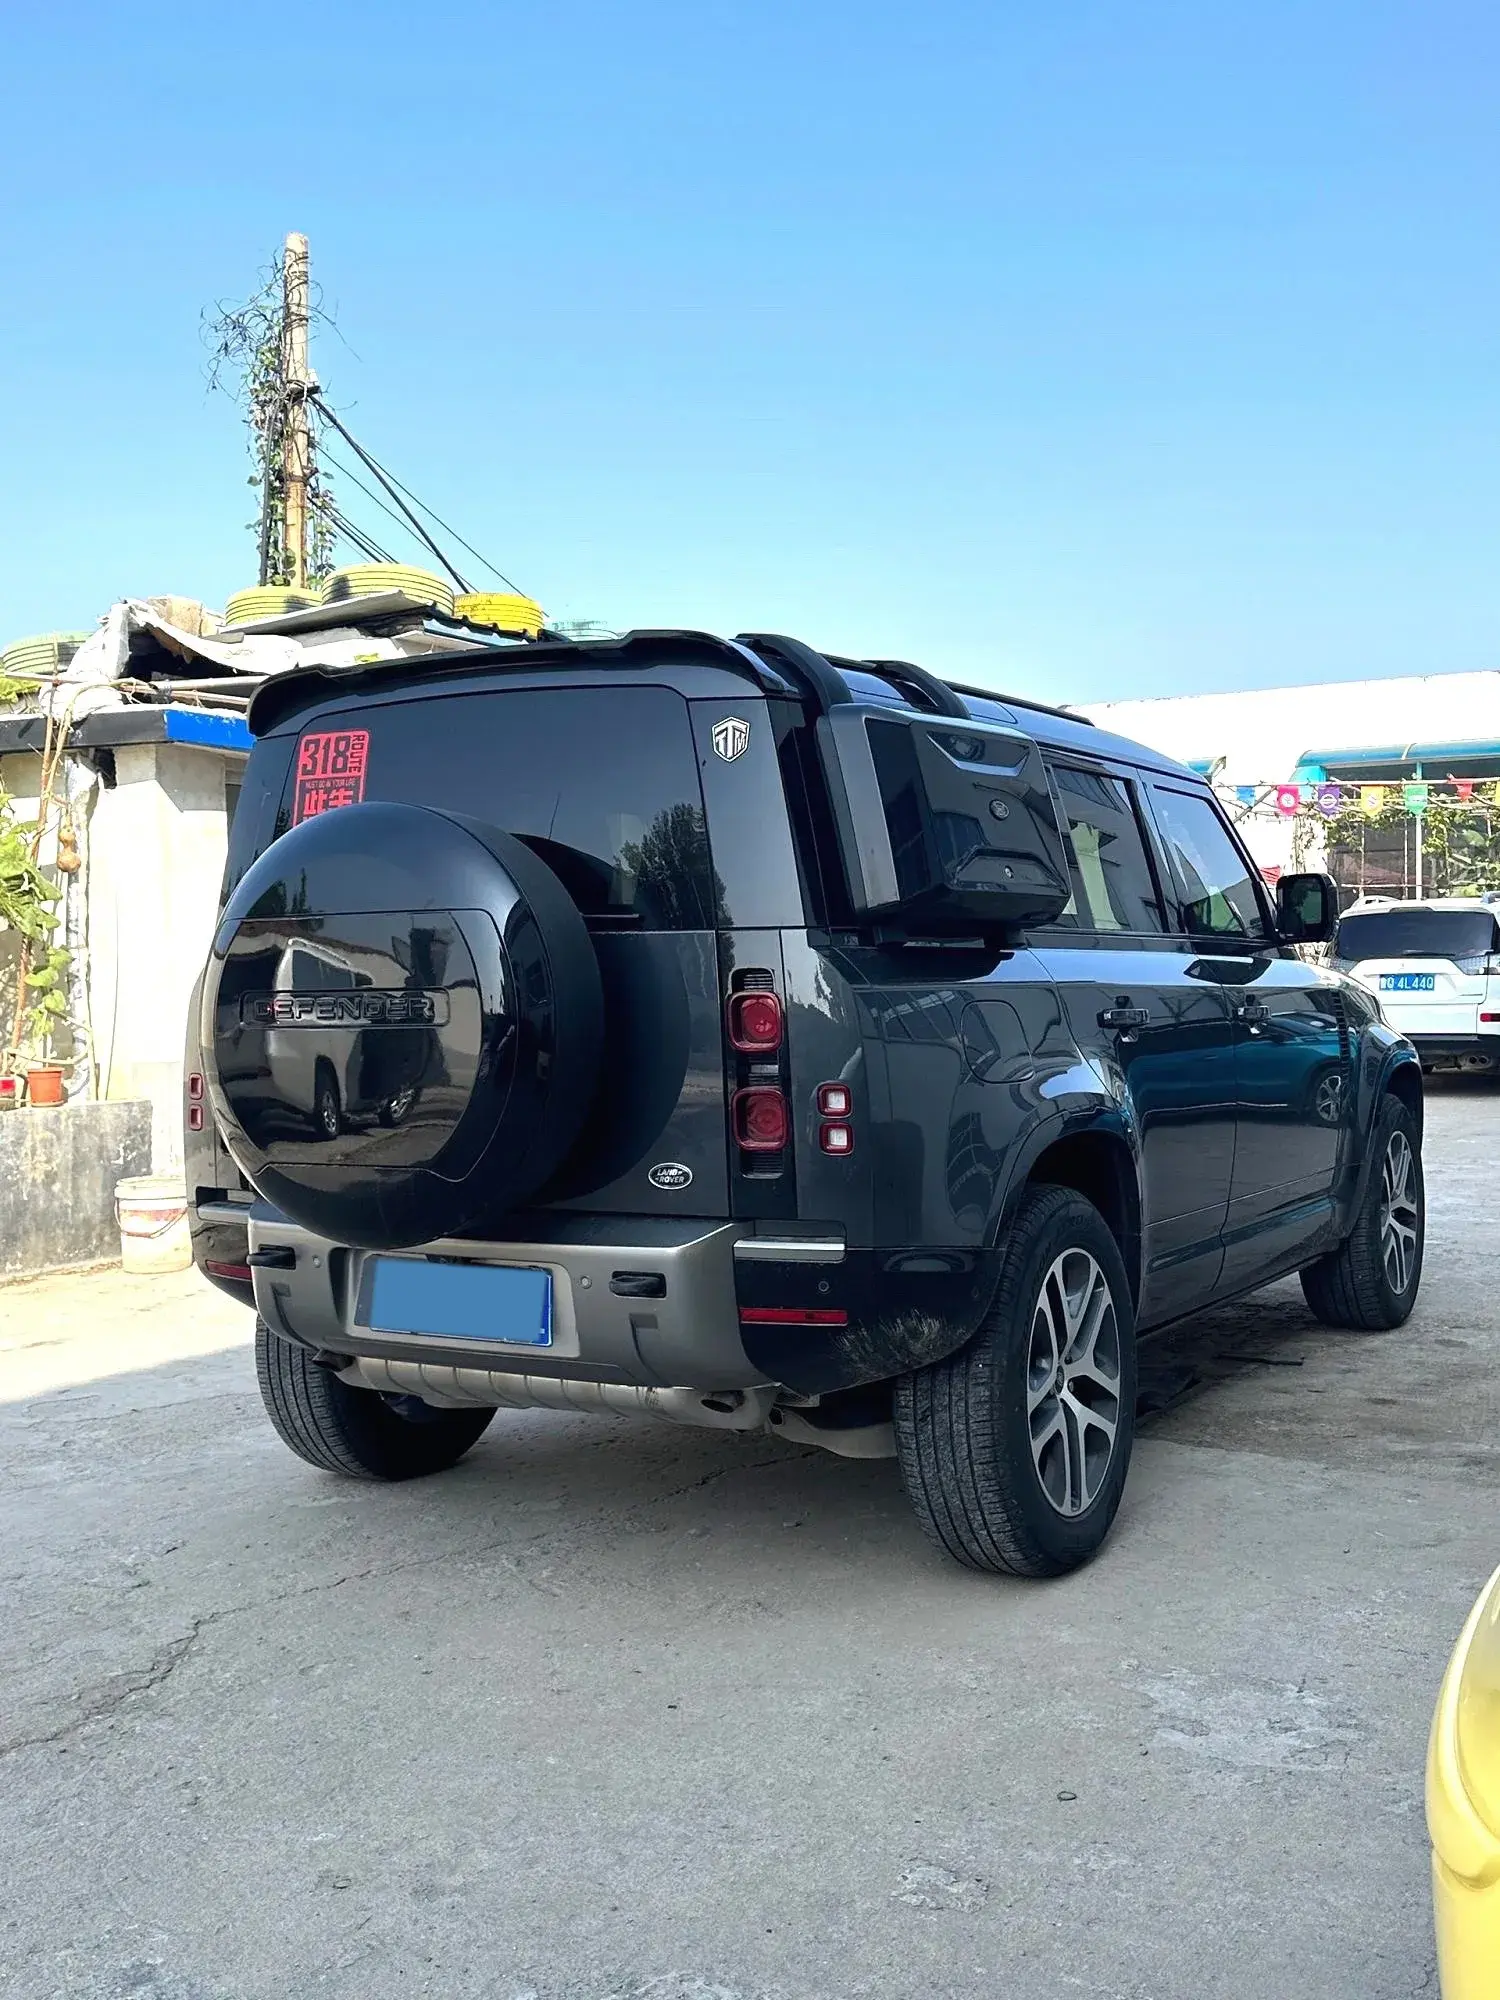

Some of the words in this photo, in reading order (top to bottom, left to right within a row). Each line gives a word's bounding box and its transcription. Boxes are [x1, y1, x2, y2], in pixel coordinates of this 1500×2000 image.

[301, 735, 351, 775] 318
[348, 734, 365, 773] ROUTE
[254, 996, 436, 1023] DEFENDER
[657, 1168, 679, 1176] LAND
